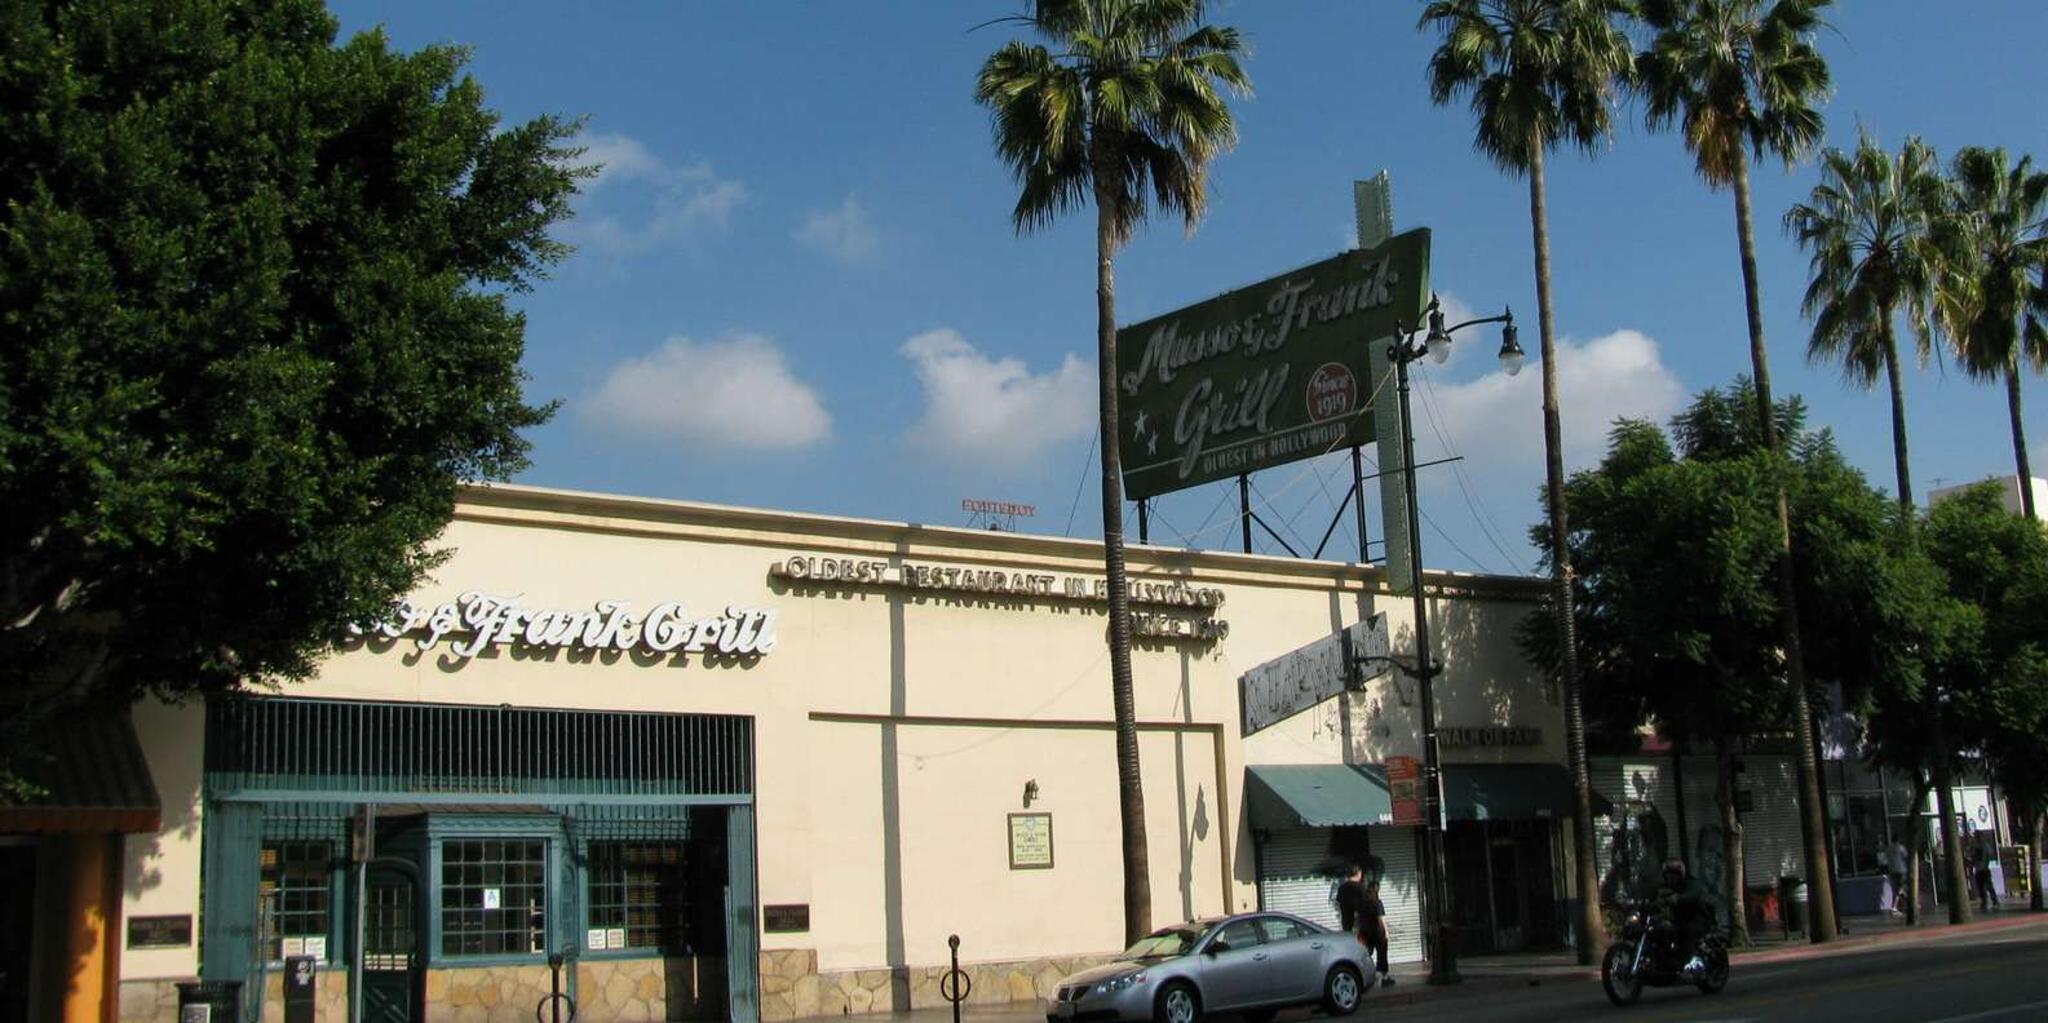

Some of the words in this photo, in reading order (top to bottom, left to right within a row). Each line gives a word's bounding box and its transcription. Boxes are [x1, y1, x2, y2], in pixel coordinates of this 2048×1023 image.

[1122, 321, 1241, 395] Musso
[1262, 254, 1400, 351] Frank
[1173, 362, 1291, 480] Grill
[1317, 391, 1347, 416] 1919
[1203, 447, 1248, 474] OLDEST
[1252, 442, 1266, 461] IN
[1271, 422, 1346, 457] HOLLYWOOD
[786, 556, 889, 584] OLDEST
[900, 564, 1055, 595] RESTAURANT
[1066, 576, 1086, 597] IN
[1095, 579, 1226, 606] HLLYWOOD
[453, 590, 638, 657] Frank
[644, 599, 781, 655] Grill
[1438, 727, 1480, 745] WALK
